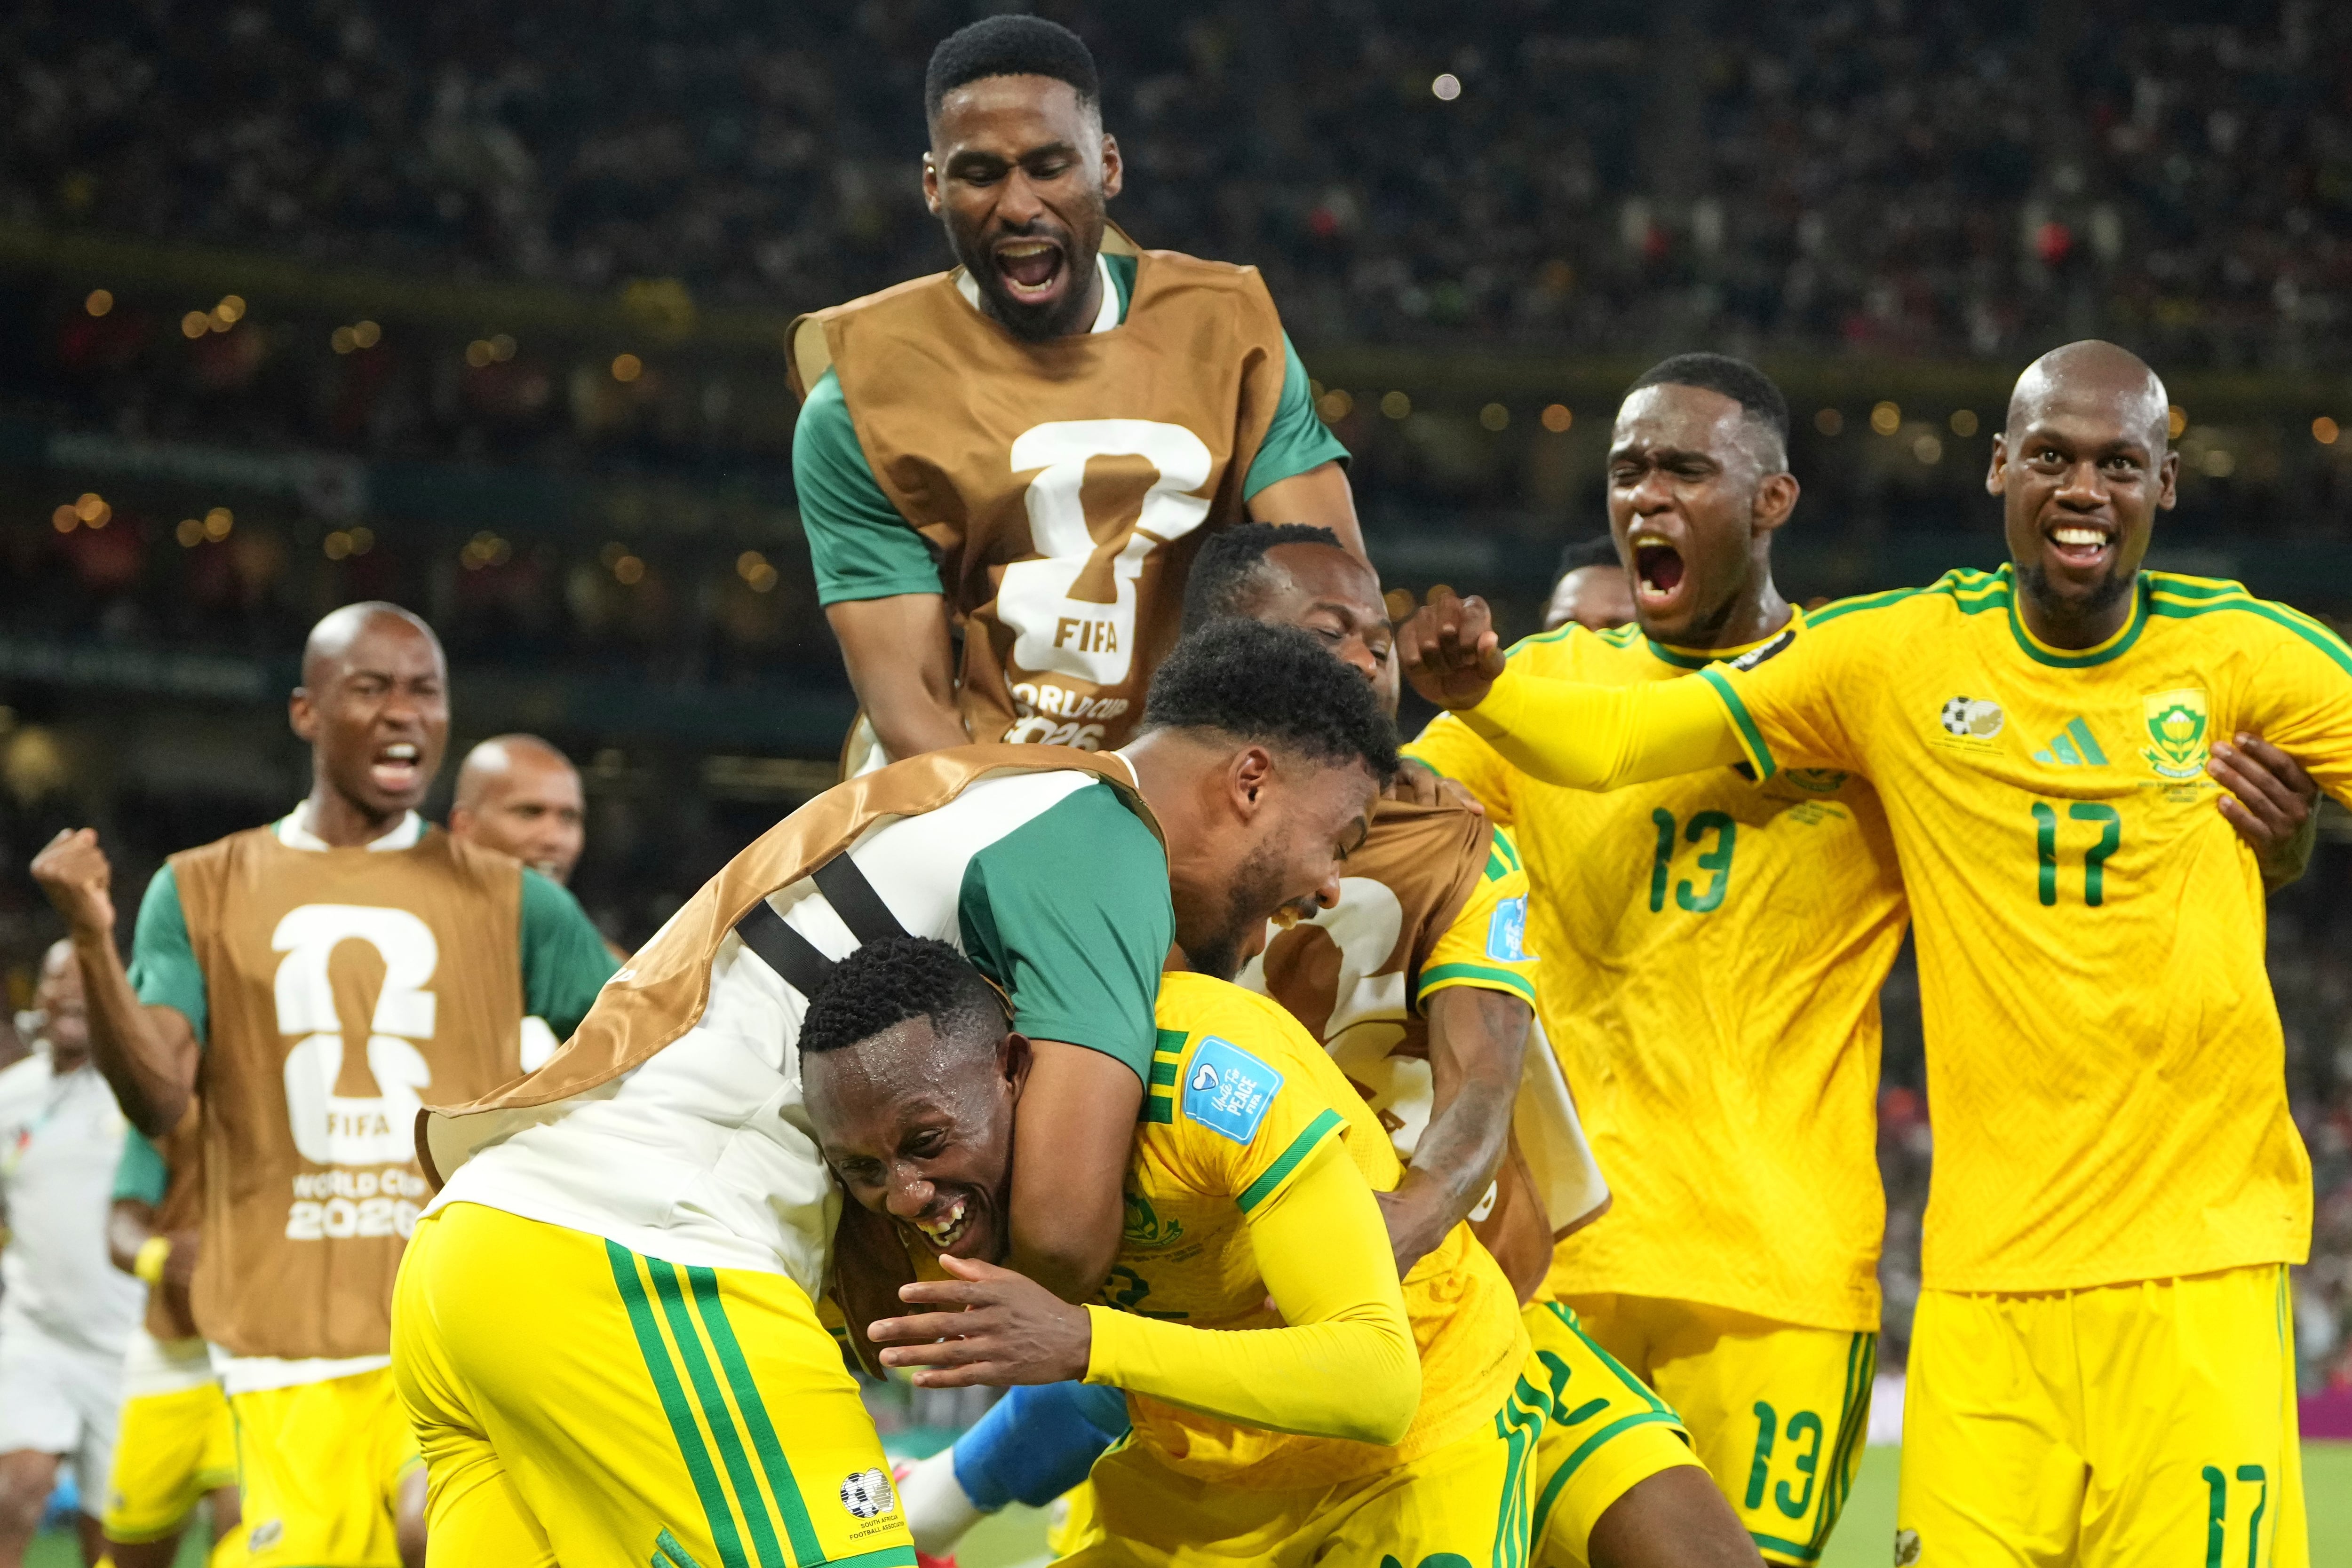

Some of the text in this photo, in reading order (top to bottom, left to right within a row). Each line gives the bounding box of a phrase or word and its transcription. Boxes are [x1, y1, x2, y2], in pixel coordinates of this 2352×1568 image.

[1053, 618, 1117, 653] FIFA
[1004, 669, 1094, 718] ORLD
[1649, 807, 1736, 913] 13
[2031, 802, 2122, 907] 17
[1211, 1069, 1240, 1111] Unite For
[1226, 1076, 1257, 1116] PEACE
[1245, 1093, 1263, 1115] FIFA
[326, 1112, 391, 1137] FIFA
[293, 1170, 378, 1199] WORLD
[285, 1197, 424, 1241] 2026
[1744, 1401, 1824, 1520] 13
[850, 1527, 881, 1540] FOOTBALL
[860, 1514, 898, 1528] SOUTH AFRICAN
[2201, 1464, 2266, 1568] 17
